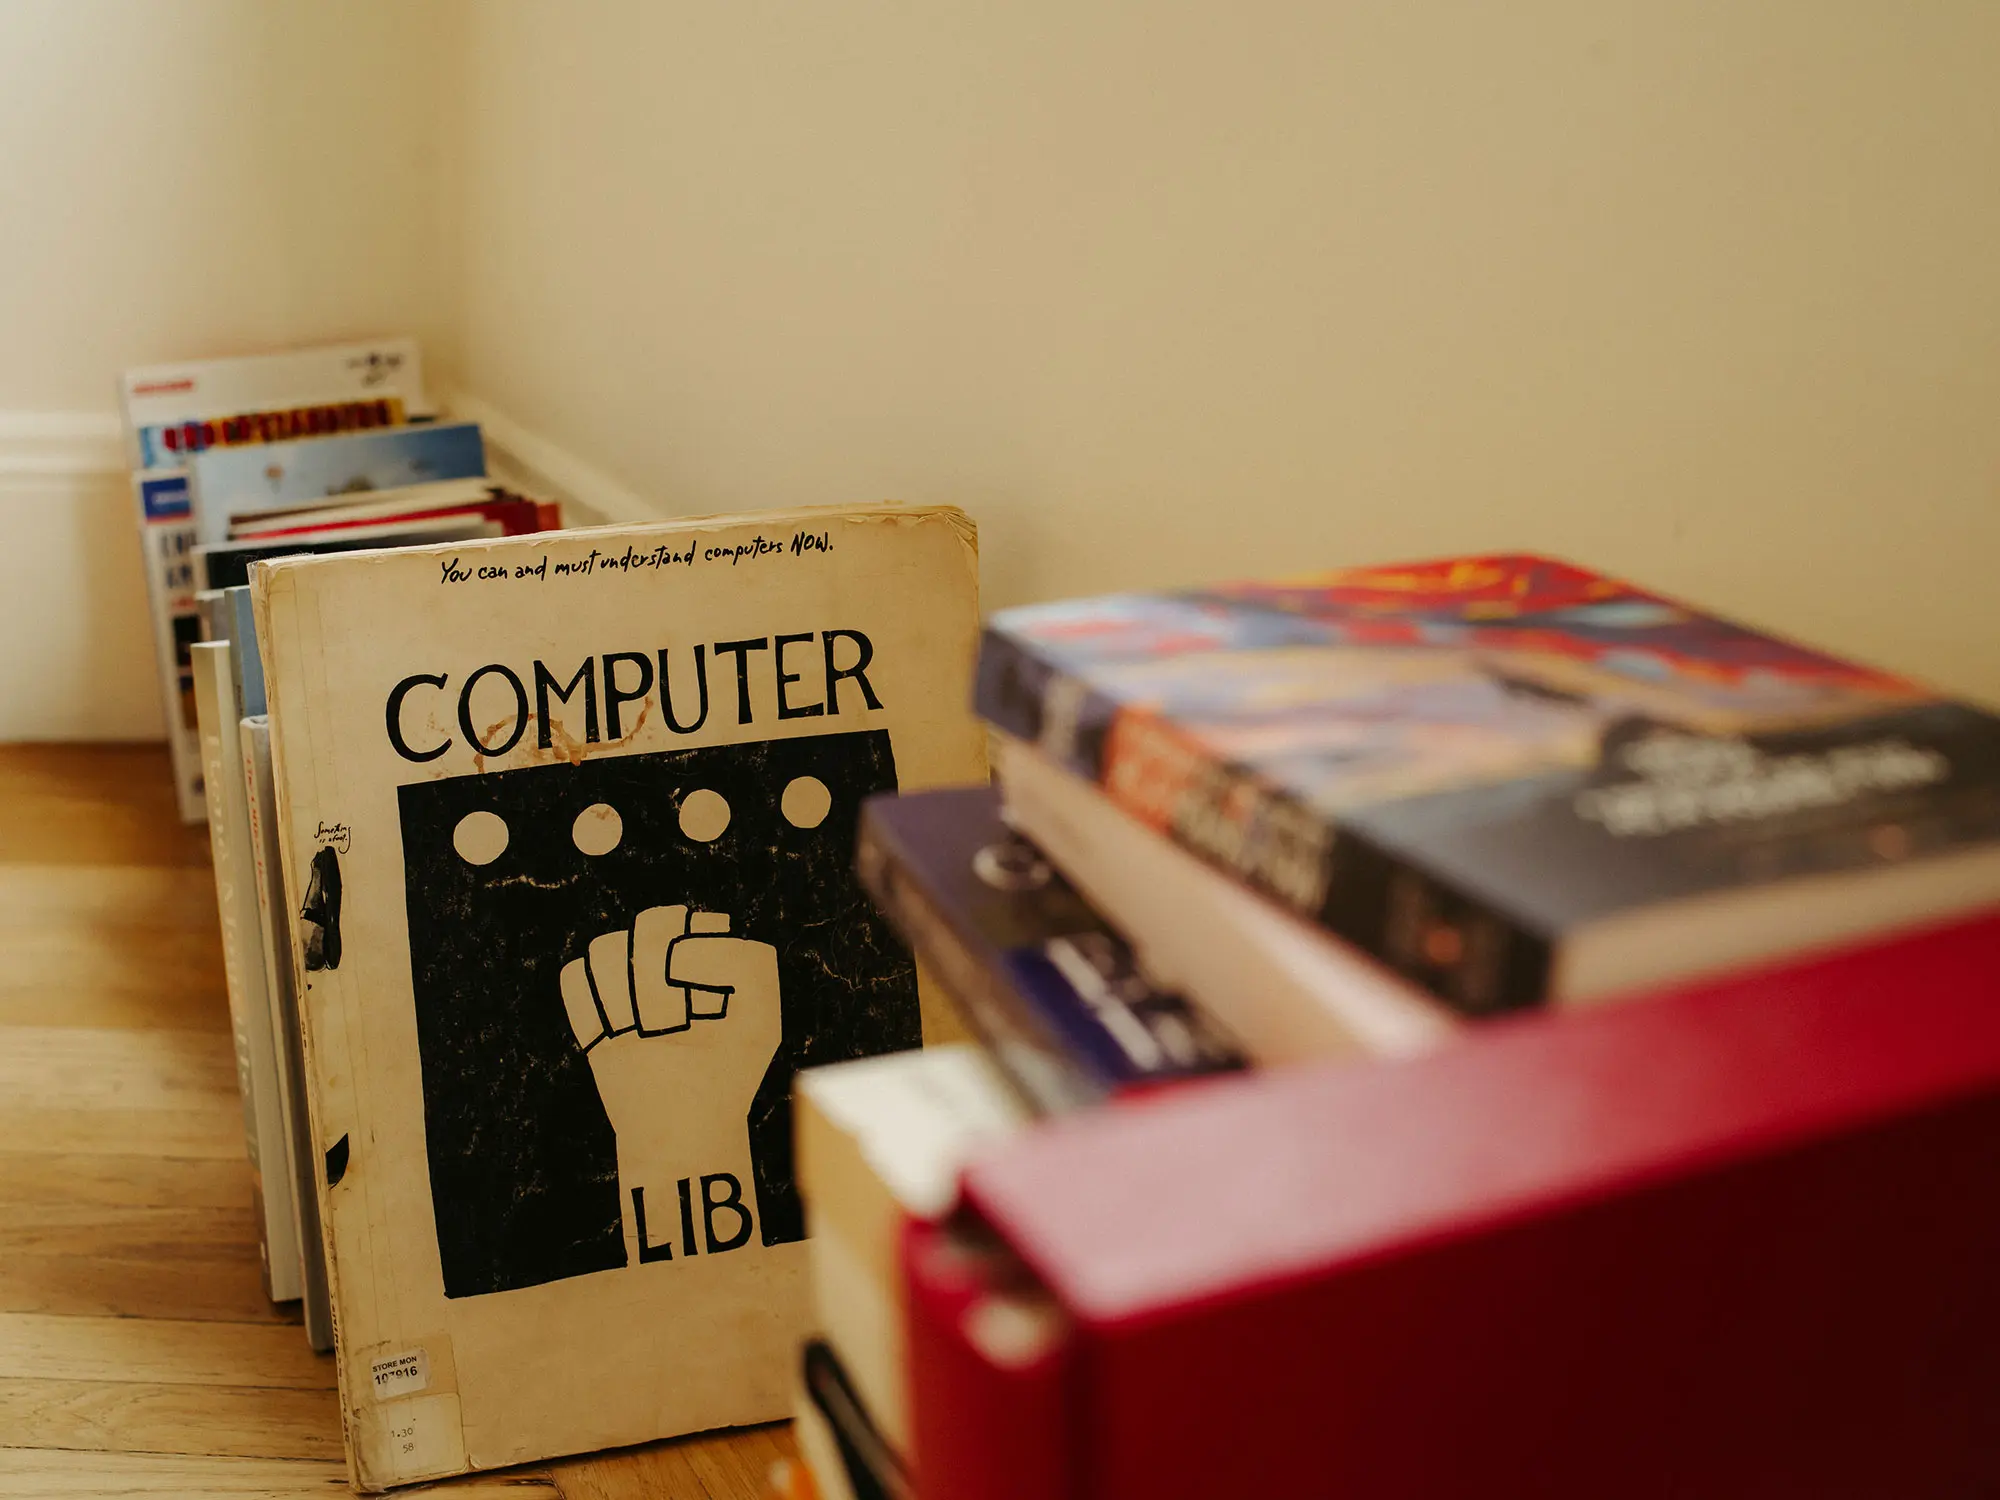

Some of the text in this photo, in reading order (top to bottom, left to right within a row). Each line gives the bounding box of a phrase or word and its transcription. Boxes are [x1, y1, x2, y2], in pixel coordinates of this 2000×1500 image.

[441, 531, 834, 585] You can and must understand computers NOW.
[385, 629, 885, 763] COMPUTER
[313, 820, 352, 855] Something
[630, 1172, 753, 1265] LIB
[372, 1355, 418, 1373] STORE MON
[402, 1442, 415, 1454] 58
